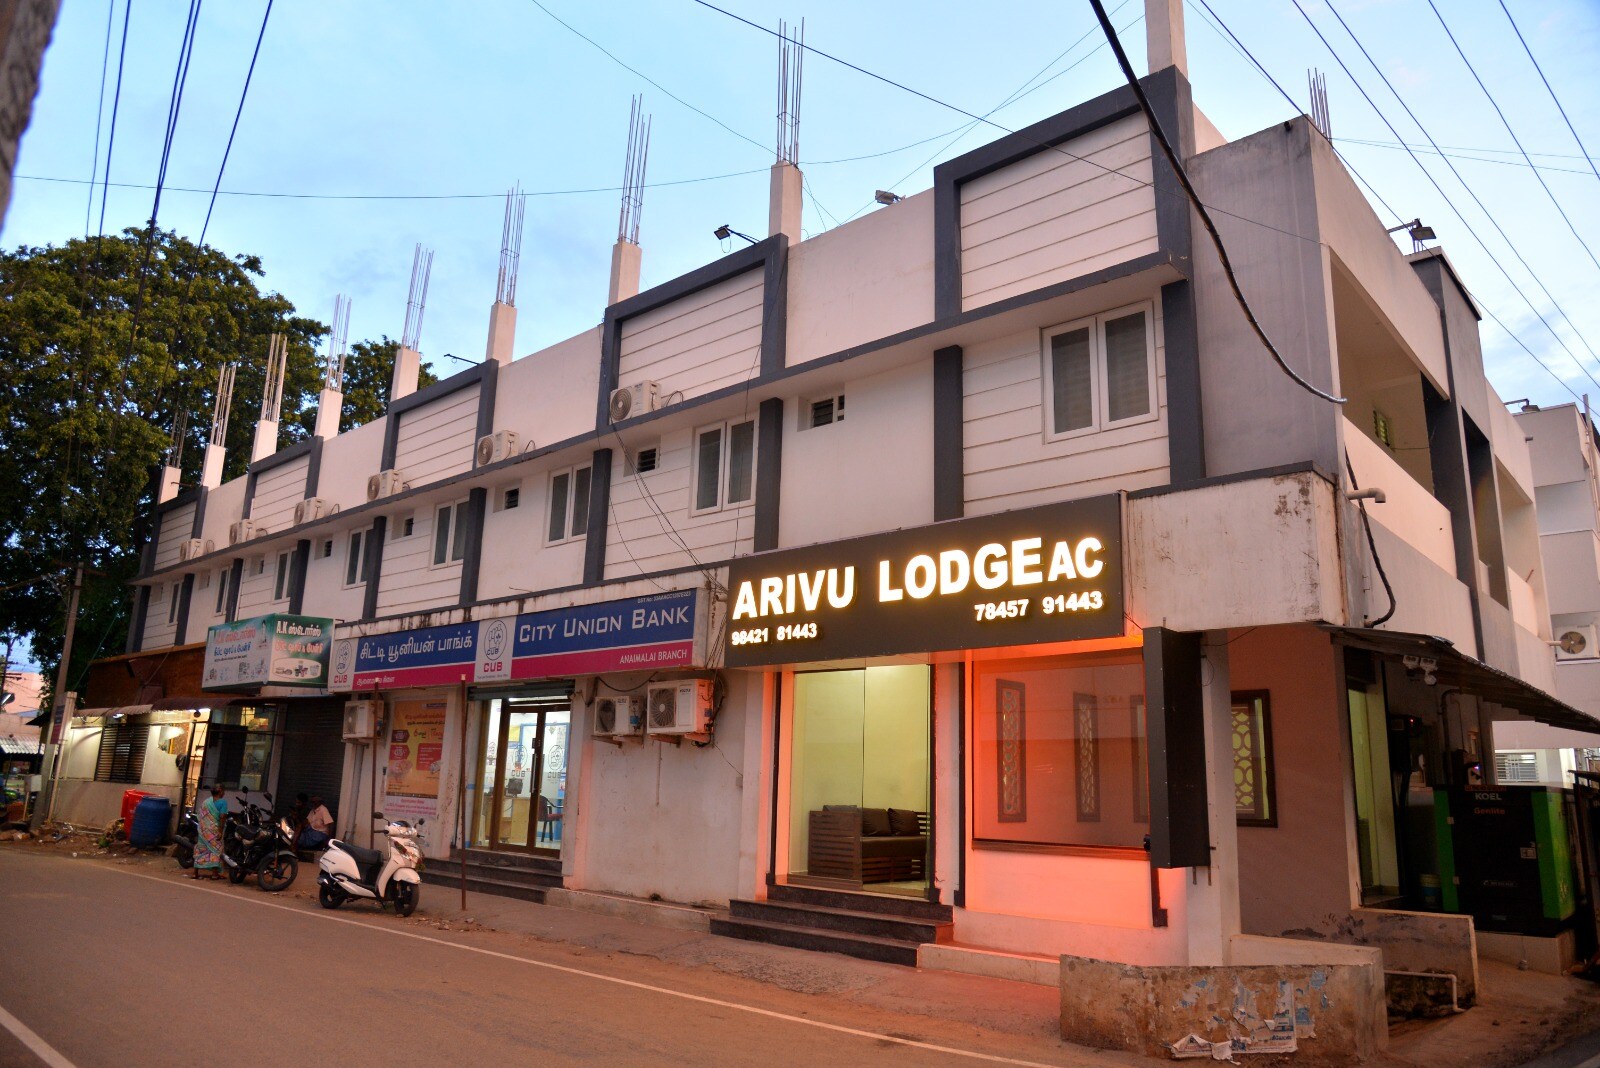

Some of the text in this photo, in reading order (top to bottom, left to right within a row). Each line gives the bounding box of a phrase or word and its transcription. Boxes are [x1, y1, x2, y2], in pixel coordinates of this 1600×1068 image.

[1047, 537, 1104, 582] AC
[732, 537, 1043, 620] ARIVU LODGE
[974, 590, 1103, 621] 78457 91443
[519, 606, 689, 643] CITY UNION BANK
[731, 622, 818, 646] 98421 81443
[360, 629, 473, 663] சிட்டி யூனியன் பாங்க்
[619, 649, 688, 665] ANAIMALAI BRANCH
[333, 674, 348, 684] CUB
[483, 661, 503, 673] CUB
[511, 769, 526, 778] CUB
[1474, 792, 1503, 801] KOEL
